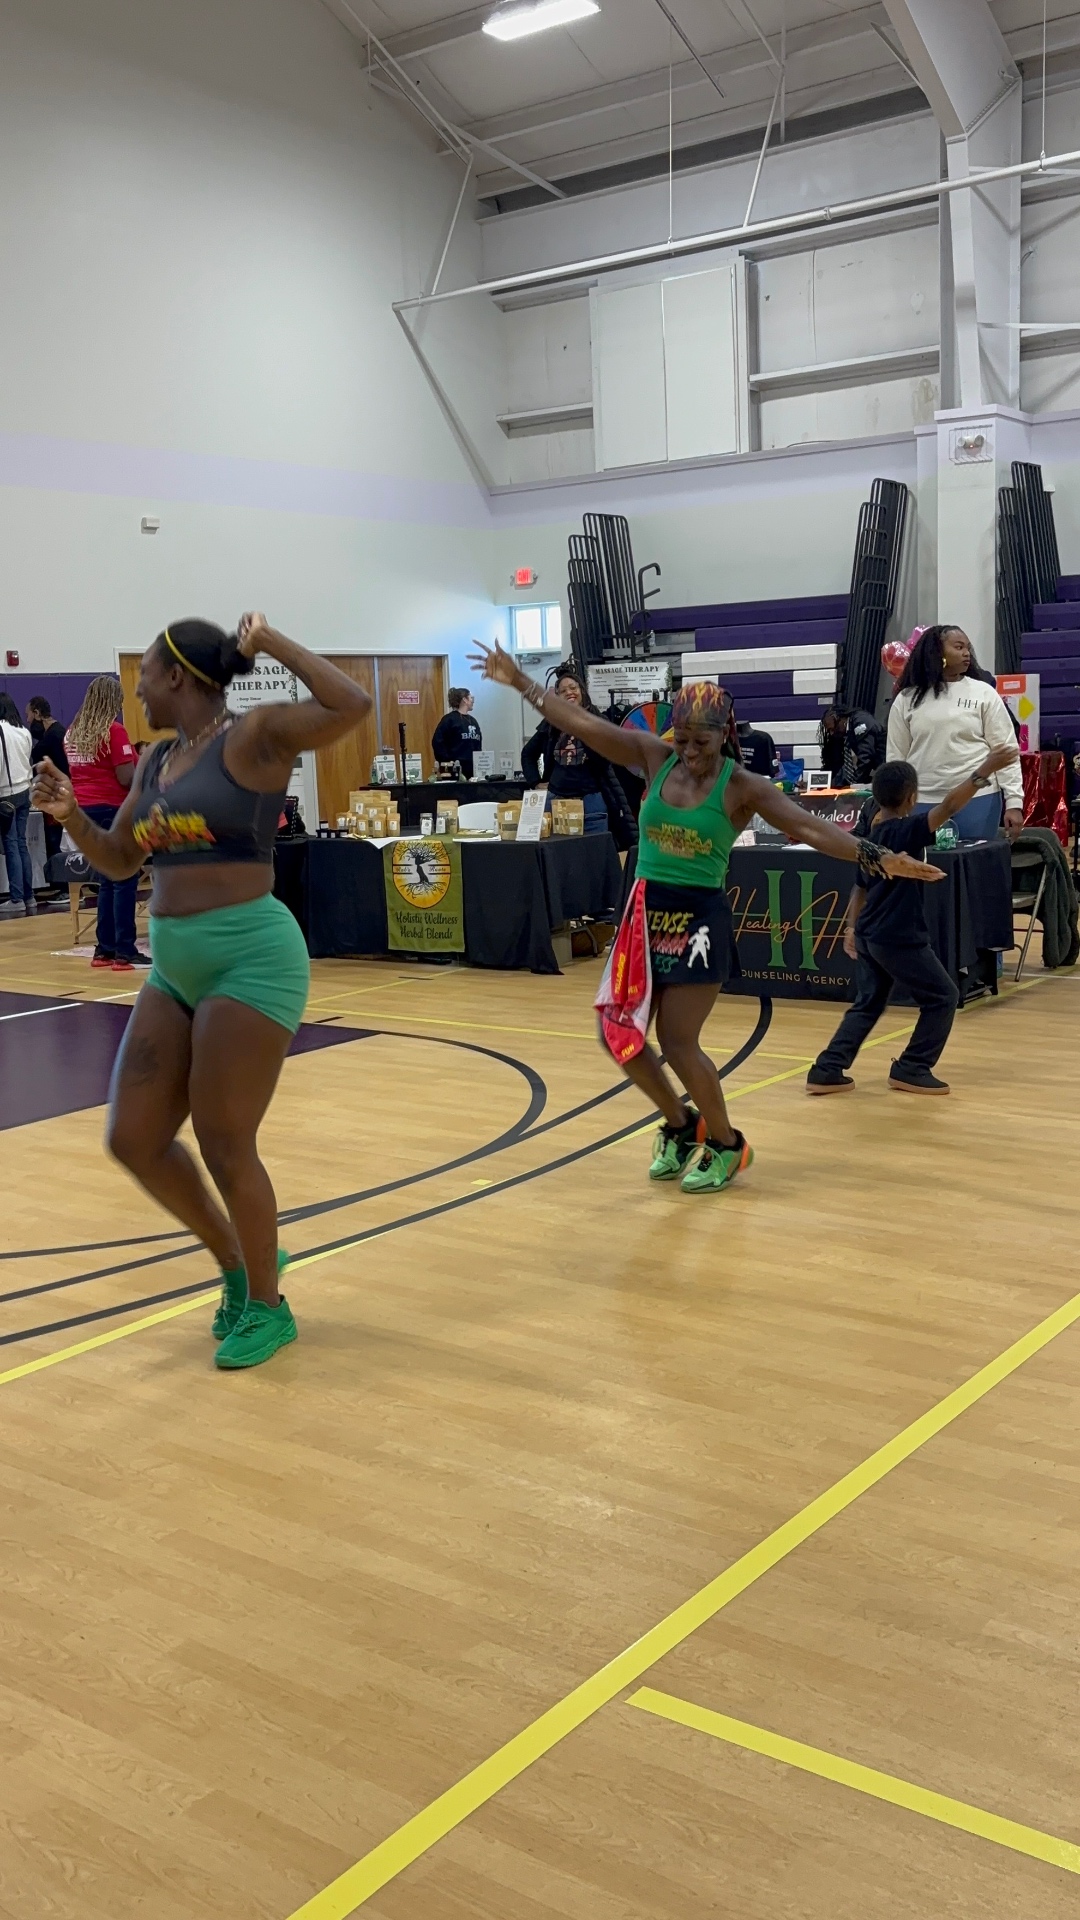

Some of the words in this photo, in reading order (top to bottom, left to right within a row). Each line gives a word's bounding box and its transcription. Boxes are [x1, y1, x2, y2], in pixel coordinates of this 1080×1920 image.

[595, 666, 622, 674] MASSAGE
[624, 665, 660, 673] THERAPY
[232, 680, 288, 691] THERAPY
[424, 912, 459, 925] Wellness
[727, 886, 796, 943] Healing
[647, 910, 695, 934] TENSE
[425, 927, 454, 940] Blends
[741, 969, 801, 982] OUNSELING
[805, 974, 851, 986] AGENCY
